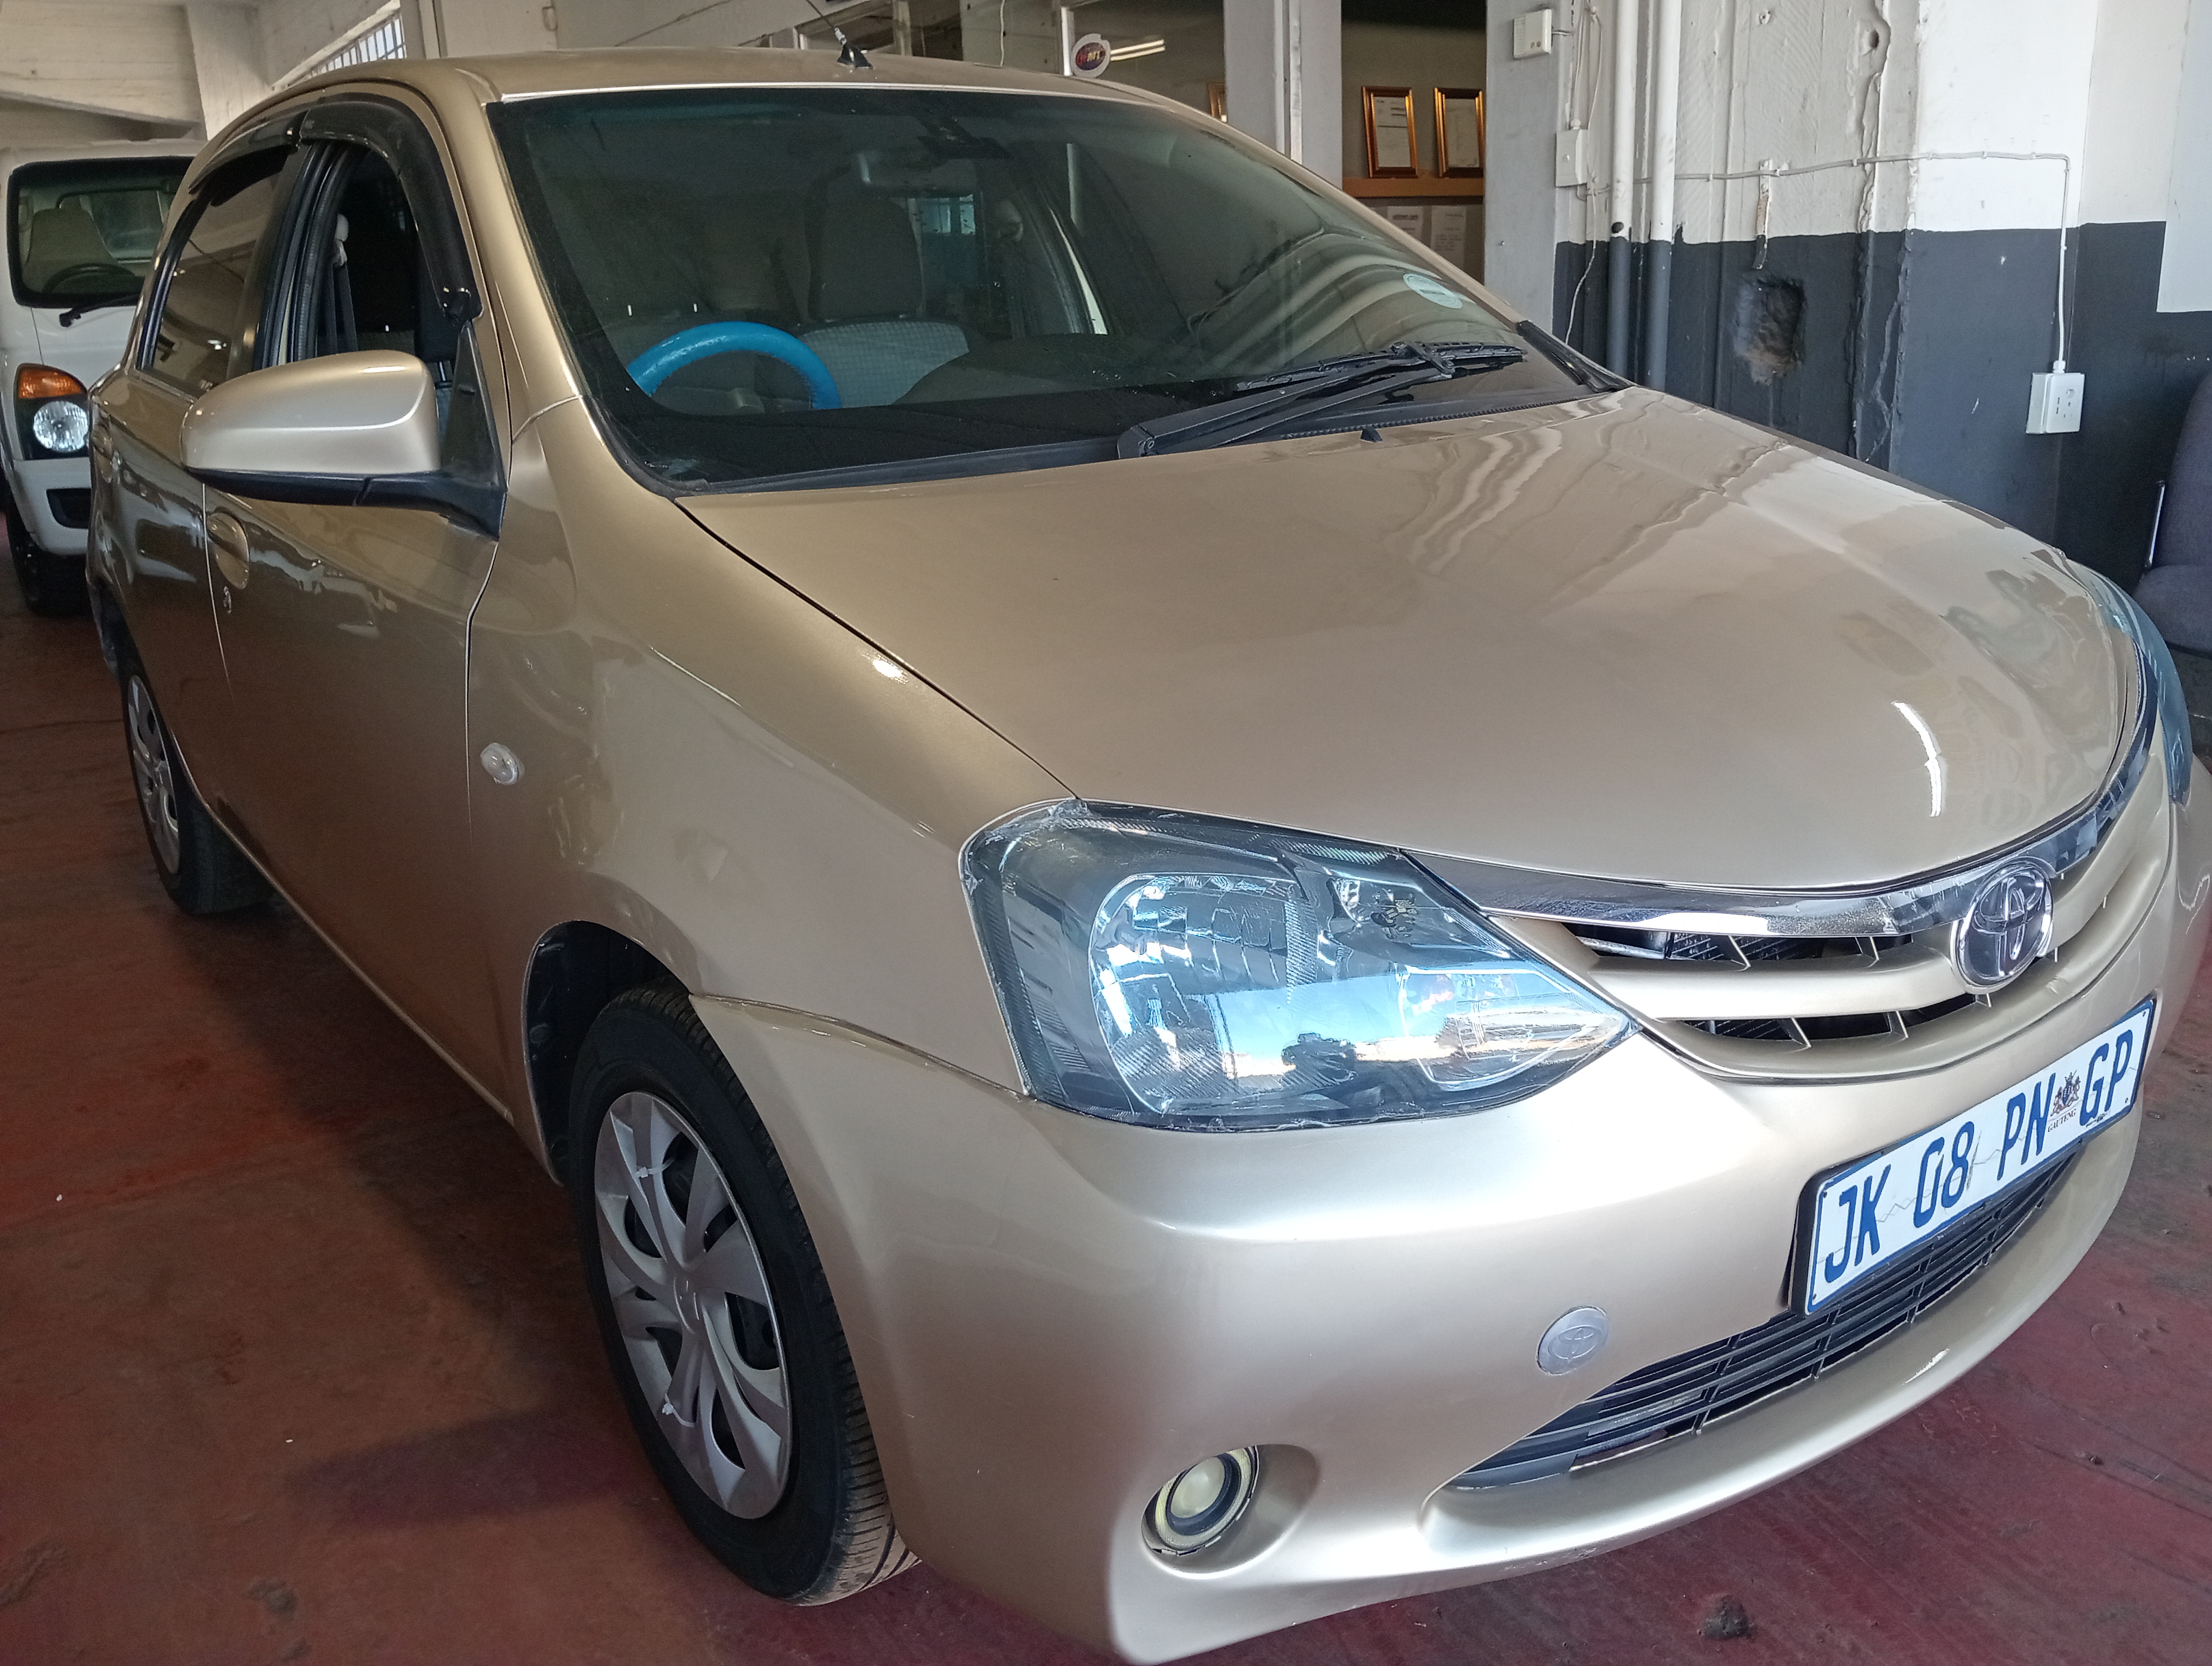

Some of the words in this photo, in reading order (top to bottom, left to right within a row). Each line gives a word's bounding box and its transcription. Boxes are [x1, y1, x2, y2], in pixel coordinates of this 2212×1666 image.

[1825, 1164, 1891, 1283] JK
[1913, 1121, 1975, 1228] 08
[1997, 1073, 2055, 1180] PN
[2080, 1029, 2133, 1126] GP
[2048, 1108, 2076, 1132] GAUTENG
